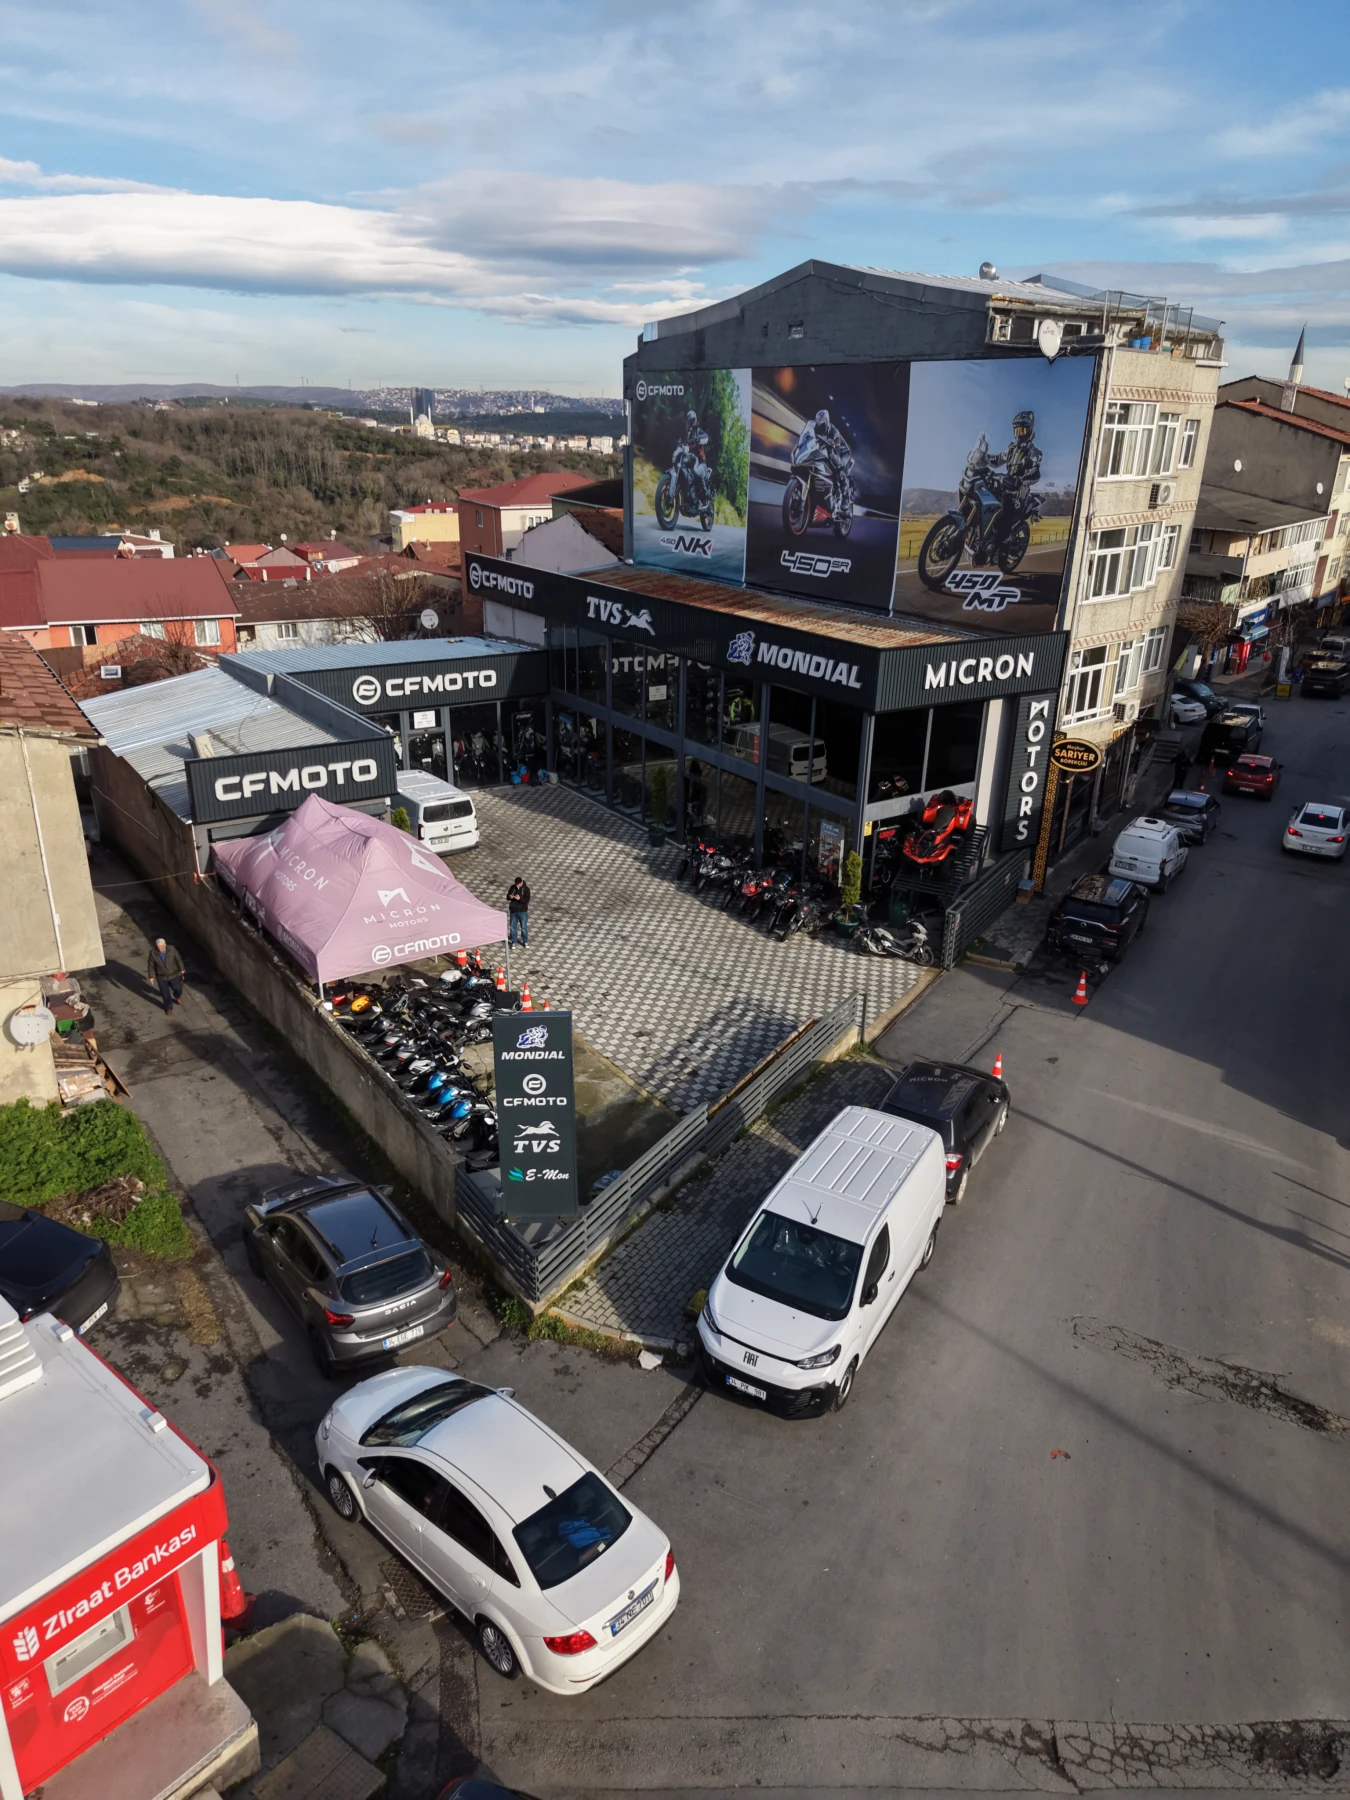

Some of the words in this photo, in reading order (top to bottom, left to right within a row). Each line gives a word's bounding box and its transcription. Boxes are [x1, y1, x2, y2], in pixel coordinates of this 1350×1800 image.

[648, 385, 684, 396] CFMOTO
[482, 570, 534, 599] CFMOTO
[586, 596, 624, 625] TVS
[963, 587, 1020, 612] MT
[756, 642, 863, 689] MONDIAL
[924, 652, 1035, 690] MICRON
[385, 669, 497, 698] CFMOTO
[1054, 748, 1096, 762] SARIYER
[214, 758, 378, 802] CFMOTO
[1015, 700, 1050, 841] MOTORS
[273, 868, 298, 892] MOTORS
[279, 845, 330, 891] MICRON
[363, 903, 441, 924] MICRON
[388, 916, 429, 929] MOTORS
[393, 932, 461, 957] CFMOTO
[501, 1051, 566, 1061] MONDIAL
[503, 1097, 568, 1107] CFMOTO
[513, 1140, 561, 1154] TVS
[525, 1168, 570, 1182] E-Mon
[384, 1299, 417, 1316] DACIA
[743, 1350, 759, 1367] FIAT
[42, 1580, 114, 1641] Ziraat
[113, 1523, 197, 1591] Bankası
